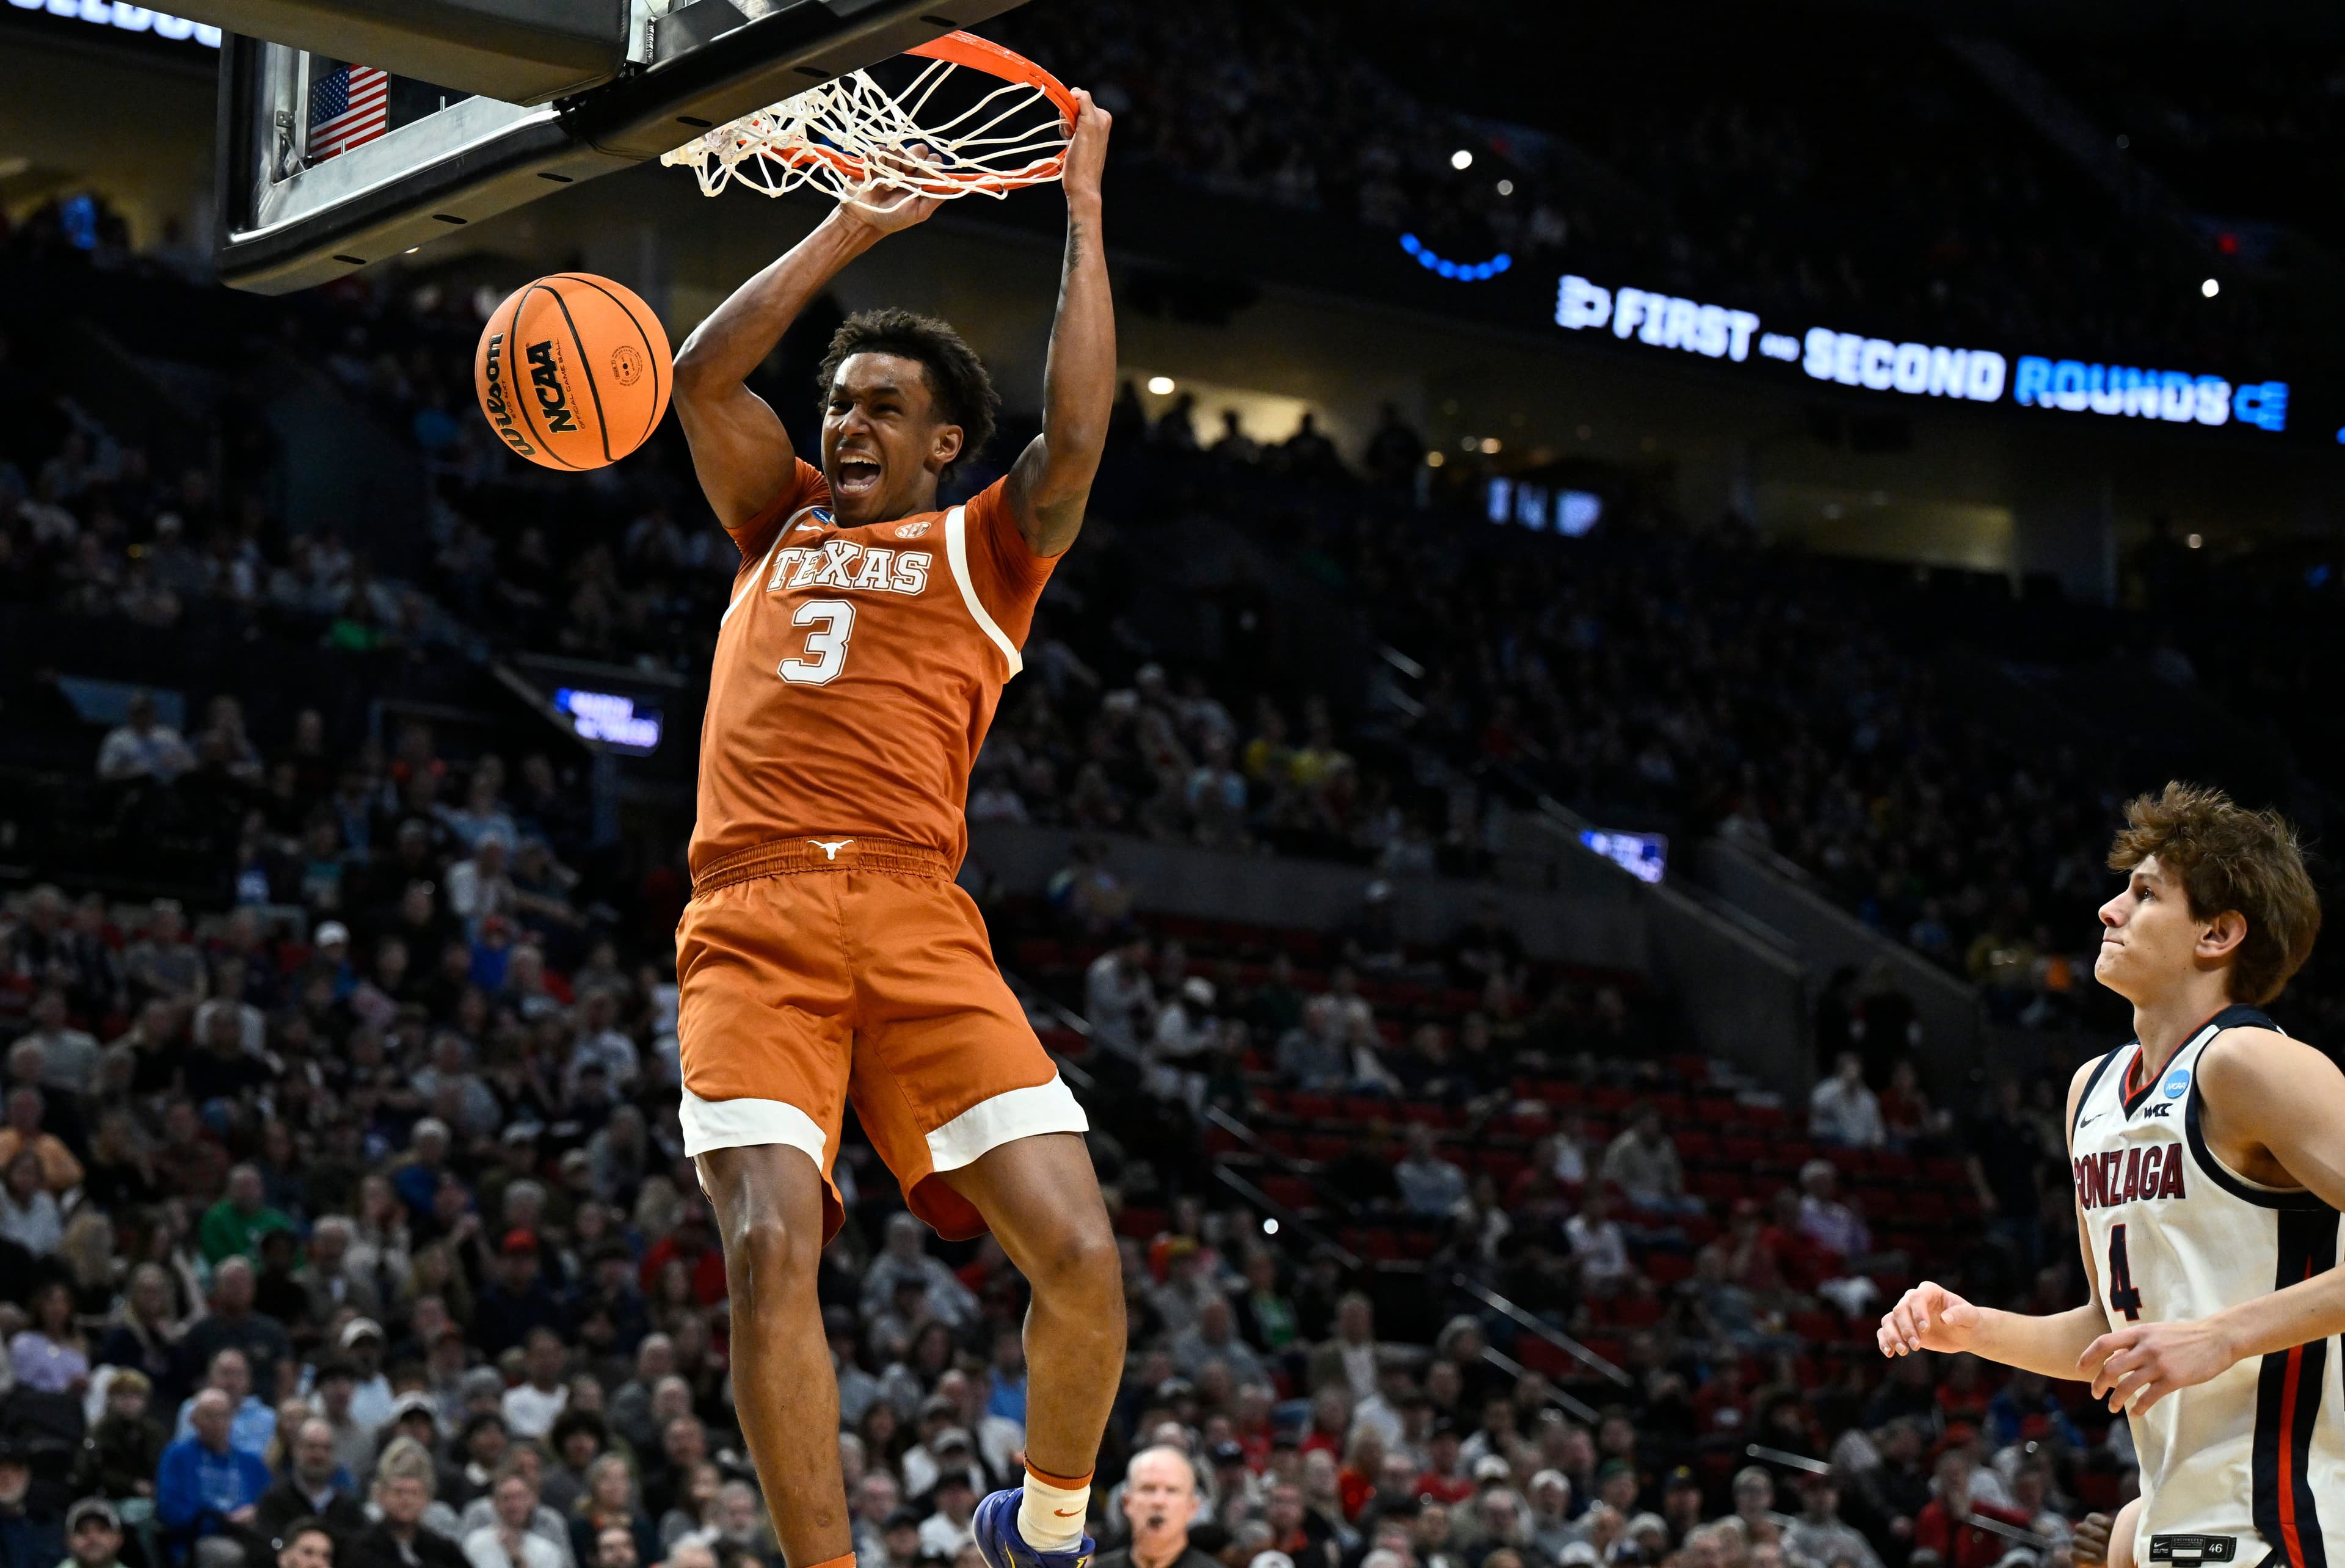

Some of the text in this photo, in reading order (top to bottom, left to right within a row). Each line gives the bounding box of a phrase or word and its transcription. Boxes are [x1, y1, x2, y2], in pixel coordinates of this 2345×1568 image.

[561, 365, 572, 392] GAME
[1613, 287, 2231, 426] FIRST SECOND ROUNDS
[526, 339, 578, 434] NCAA
[569, 394, 586, 429] OFFICIAL
[898, 523, 929, 537] SEC
[766, 540, 933, 596] TEXAS
[777, 600, 856, 686] 3
[2109, 1223, 2143, 1321] 4
[2208, 1544, 2223, 1553] 46
